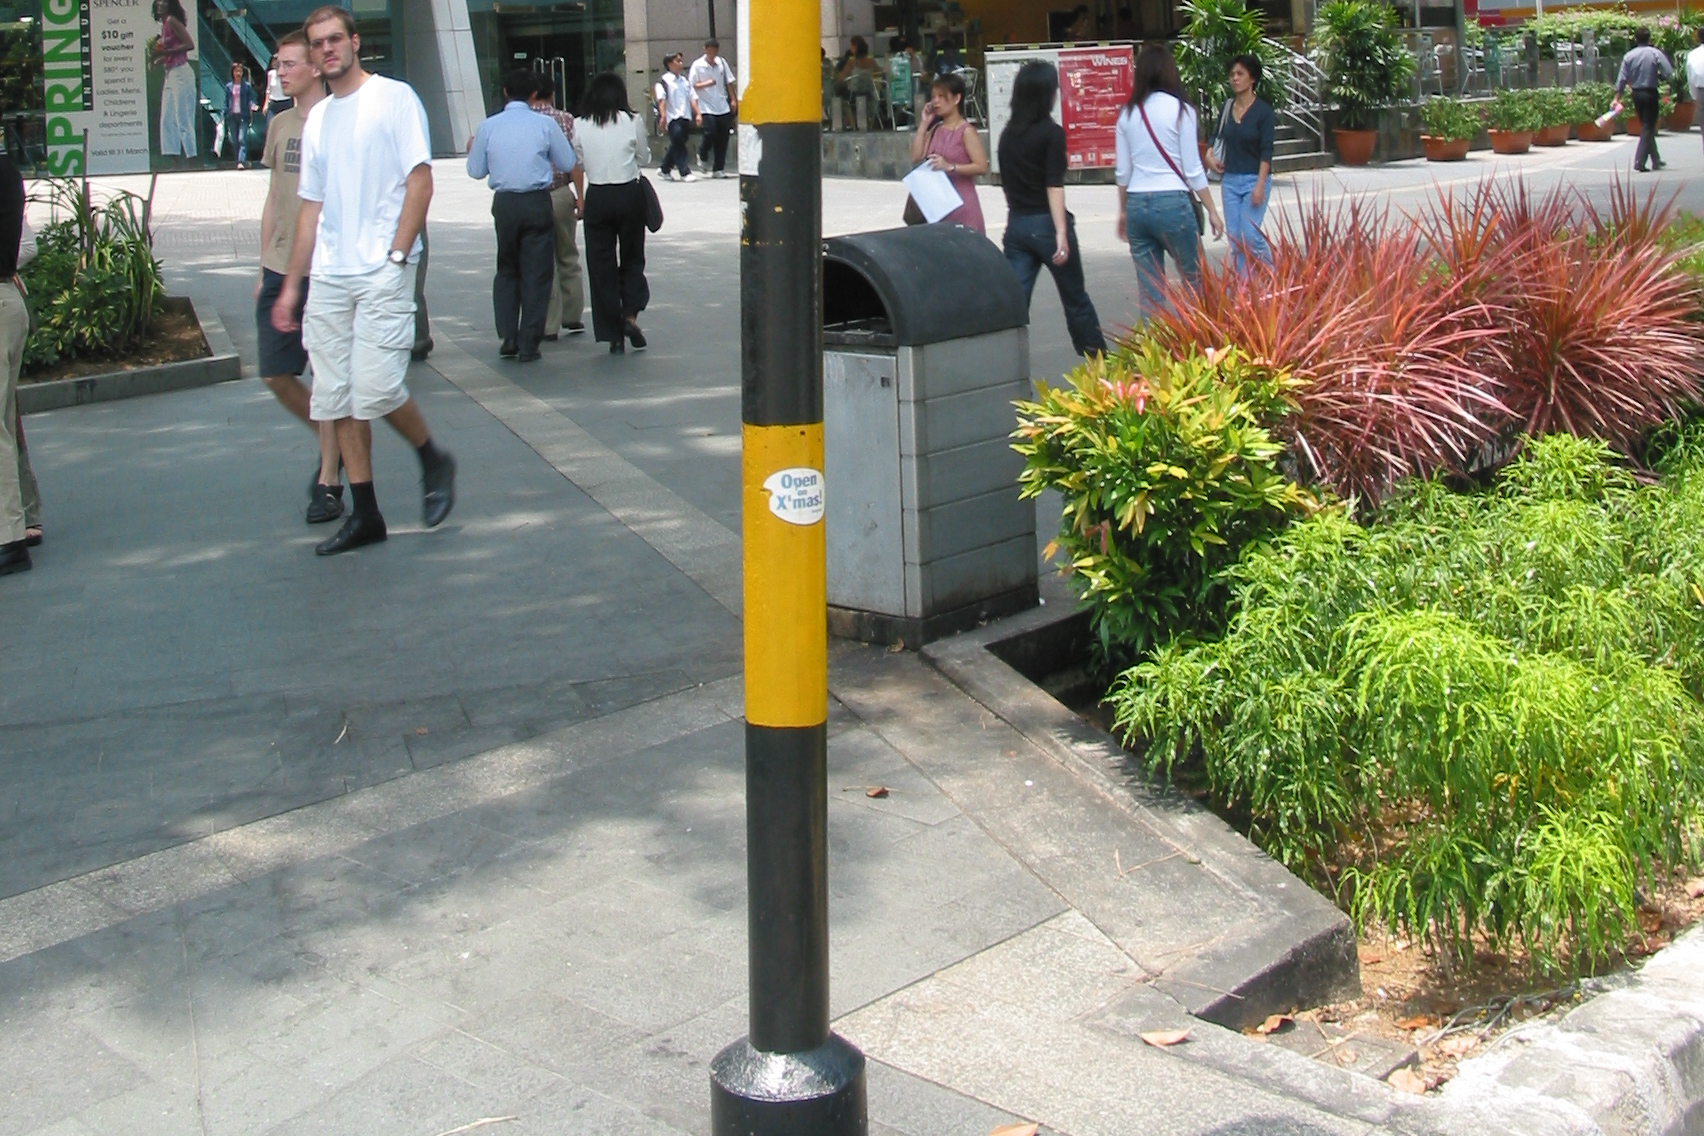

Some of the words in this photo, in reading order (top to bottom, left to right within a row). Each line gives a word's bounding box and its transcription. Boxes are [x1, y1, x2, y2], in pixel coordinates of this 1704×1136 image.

[101, 30, 119, 39] $10
[781, 473, 817, 491] Open
[776, 489, 823, 511] X'mas!
